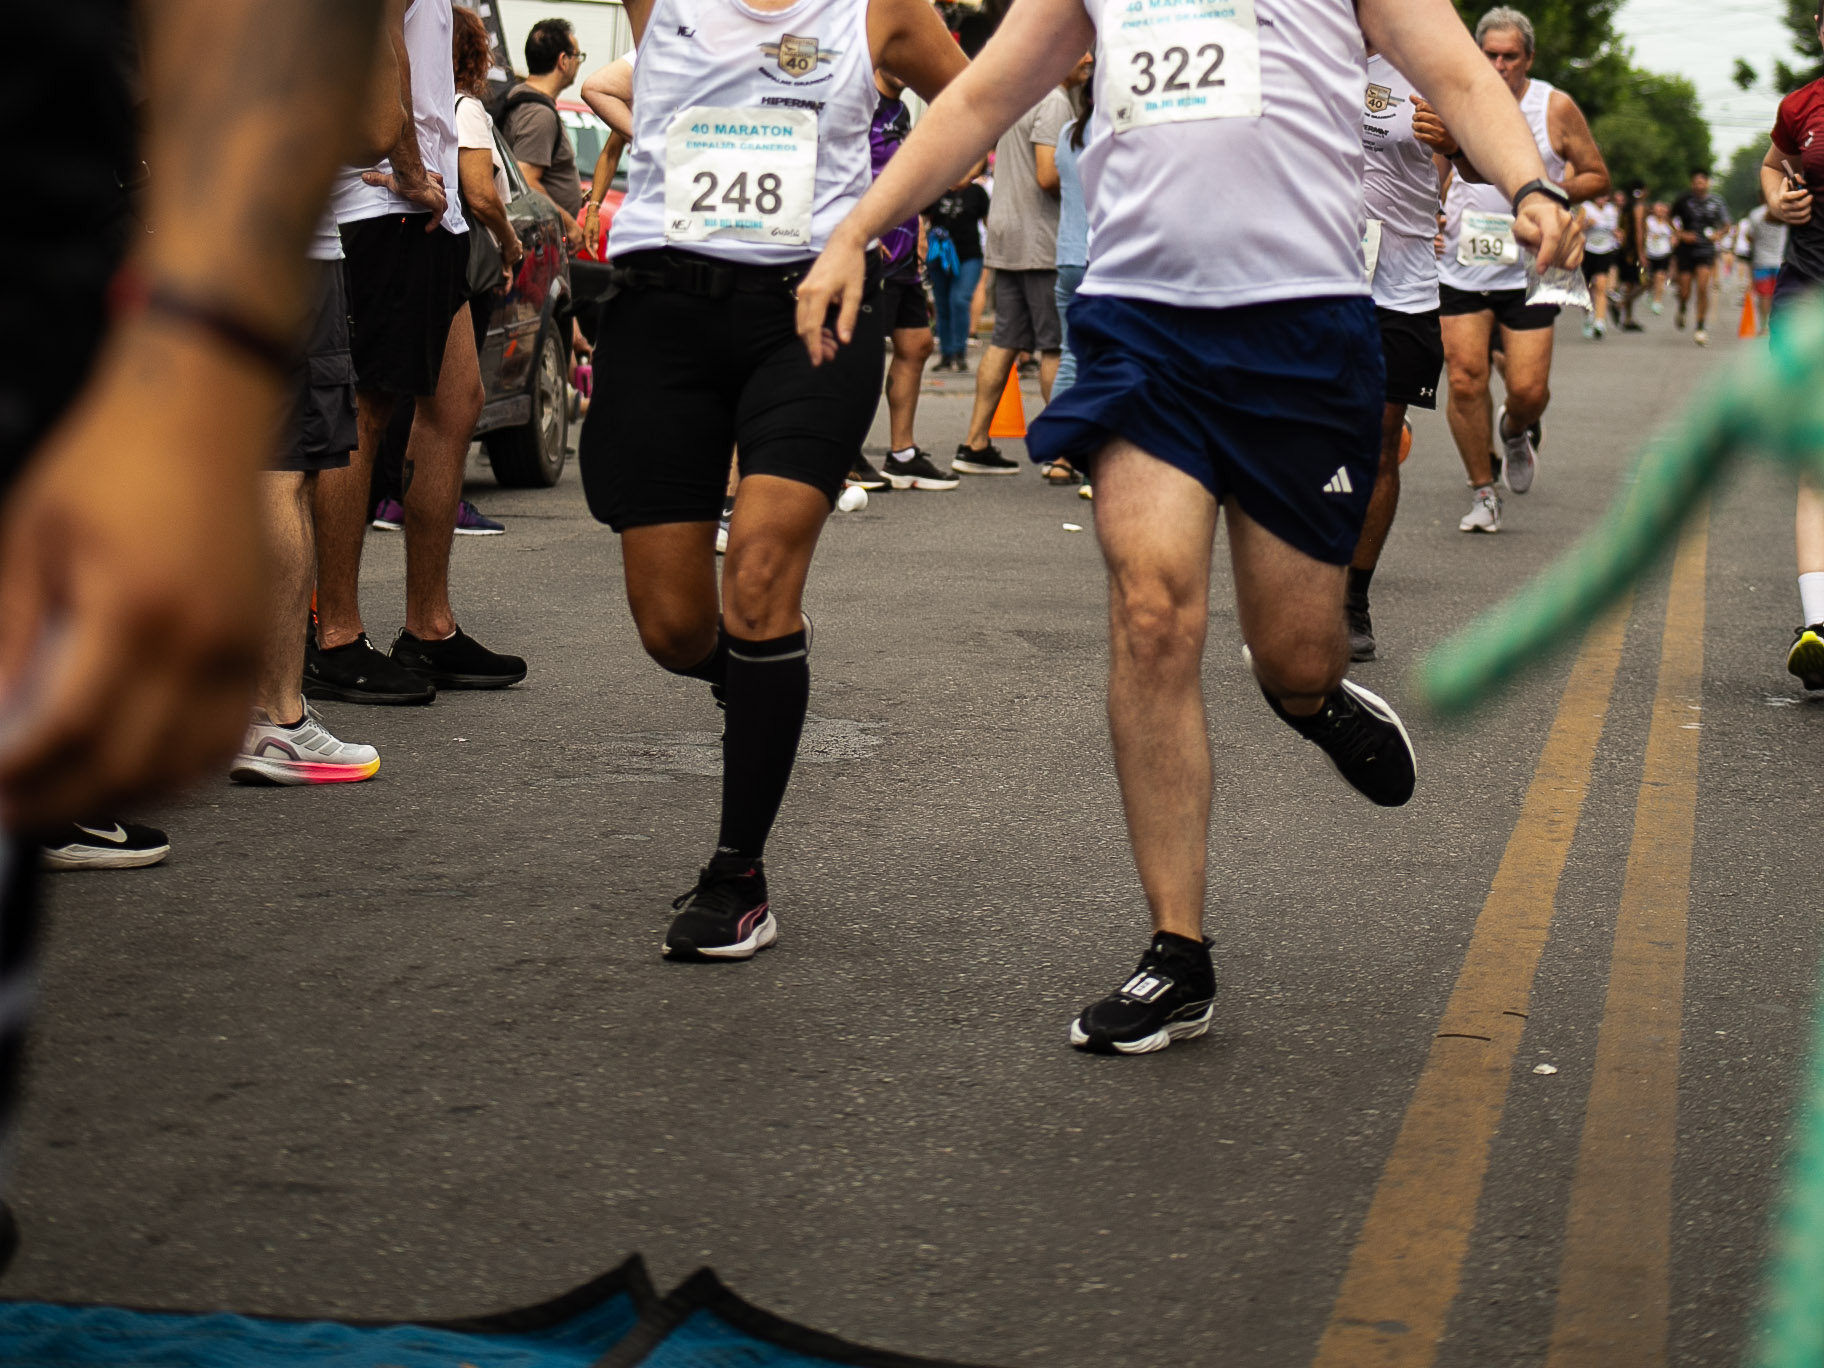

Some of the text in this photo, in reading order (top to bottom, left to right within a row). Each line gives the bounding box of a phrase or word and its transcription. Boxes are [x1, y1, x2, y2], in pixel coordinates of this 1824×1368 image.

[786, 57, 808, 71] 40
[1131, 43, 1225, 96] 322
[1368, 99, 1383, 108] 40
[691, 123, 793, 137] 40 MARATON
[691, 172, 782, 215] 248
[1469, 237, 1503, 256] 139
